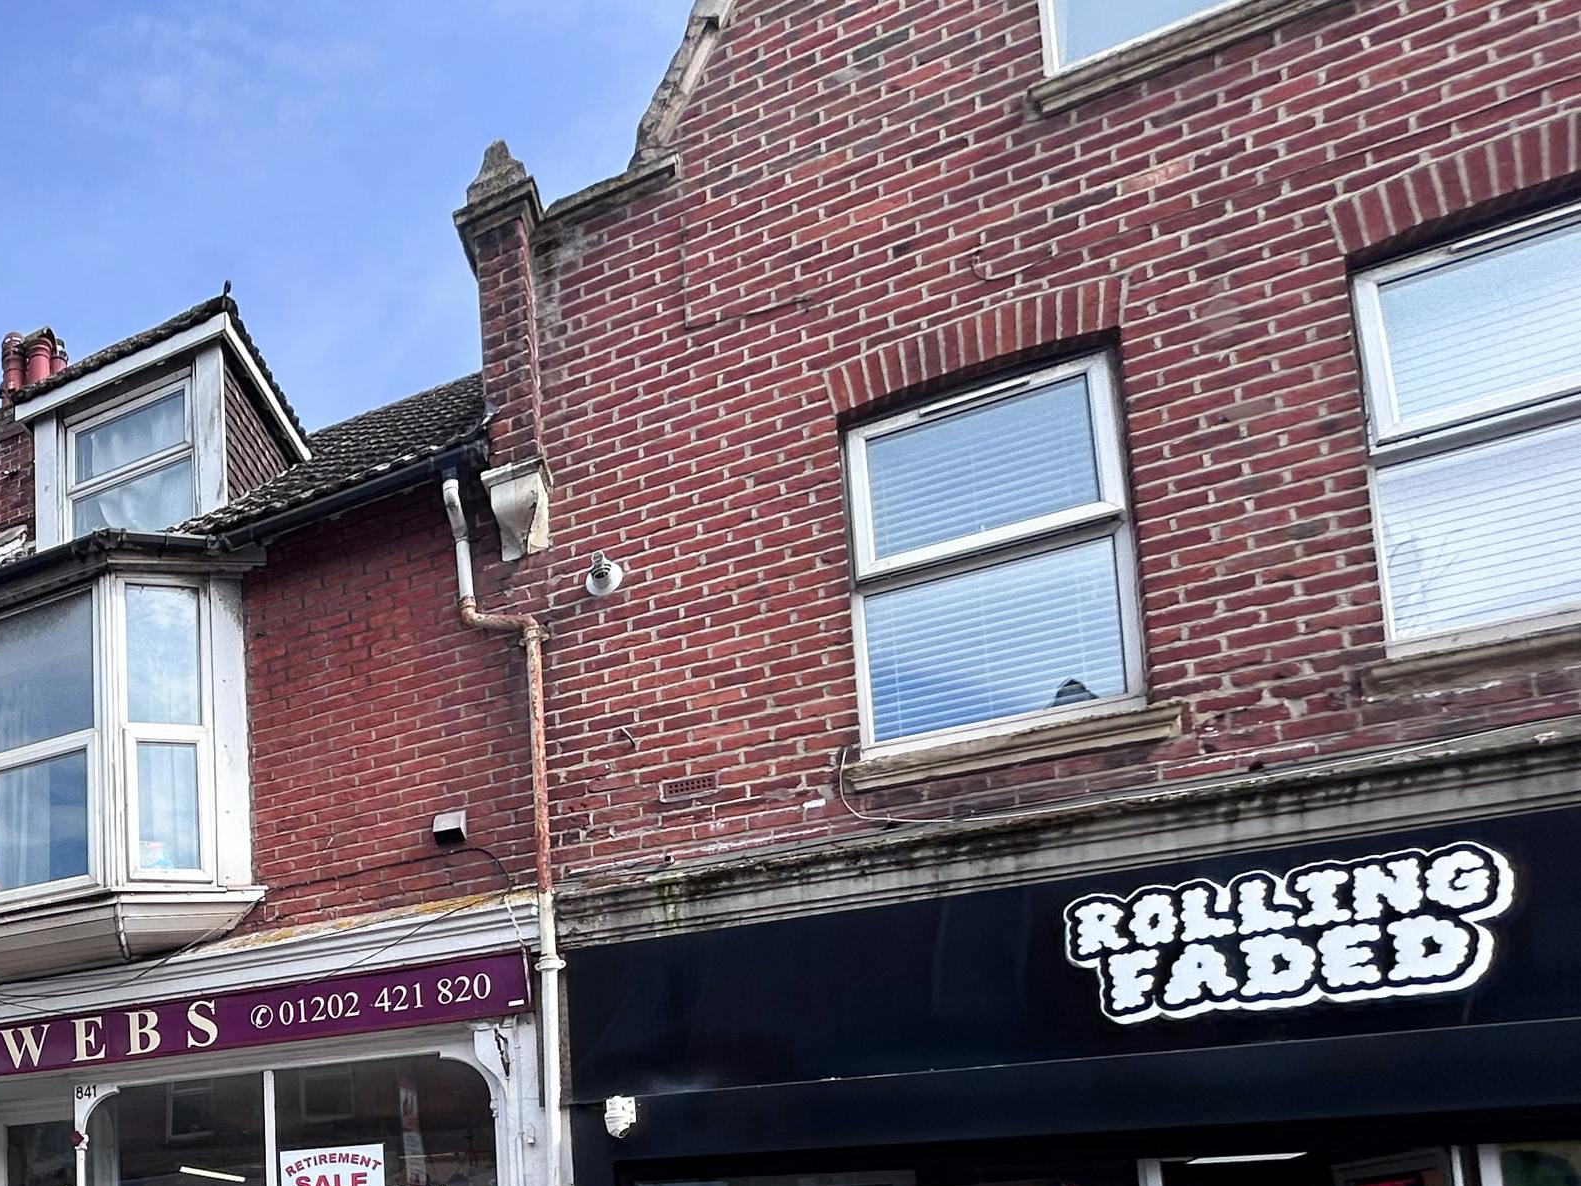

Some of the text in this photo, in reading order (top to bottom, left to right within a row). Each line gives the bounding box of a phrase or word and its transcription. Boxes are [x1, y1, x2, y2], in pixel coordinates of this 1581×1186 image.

[1074, 849, 1491, 955] ROLLING
[1107, 914, 1471, 1010] FADED
[278, 972, 492, 1026] 01202 421 820
[75, 1084, 98, 1100] 841
[284, 1152, 383, 1178] RETIREMENT
